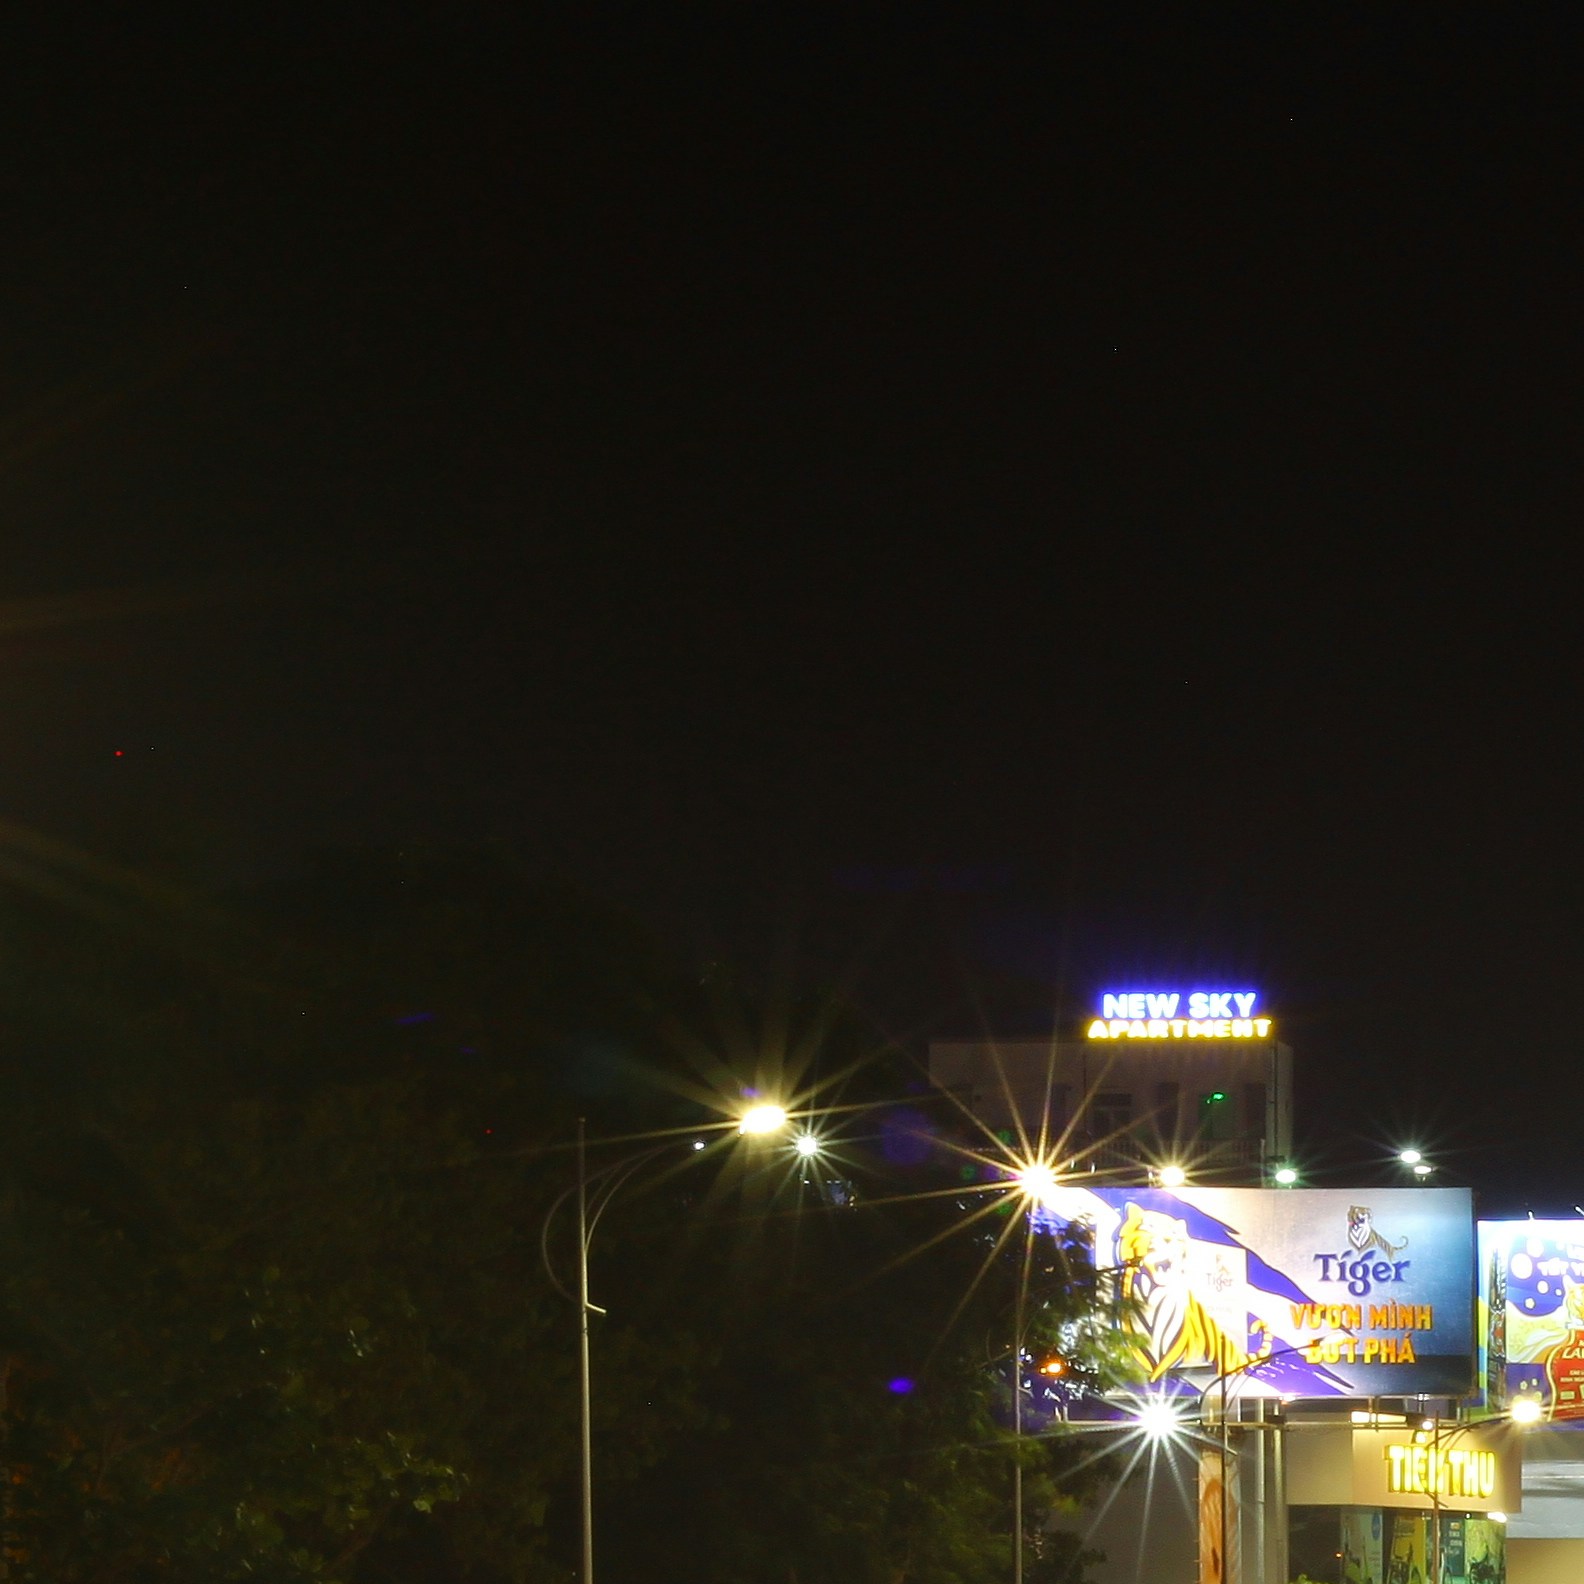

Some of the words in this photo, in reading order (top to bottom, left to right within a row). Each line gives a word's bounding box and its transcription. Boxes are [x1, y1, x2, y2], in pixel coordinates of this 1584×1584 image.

[1103, 993, 1180, 1019] NEW
[1188, 992, 1256, 1019] SKY
[1087, 1019, 1272, 1039] APARTMENT
[1313, 1250, 1411, 1297] Tiger
[1290, 1303, 1362, 1330] VƯƠN
[1369, 1297, 1433, 1330] MÌNH
[1363, 1333, 1416, 1364] PHÁ
[1447, 1449, 1496, 1498] THU
